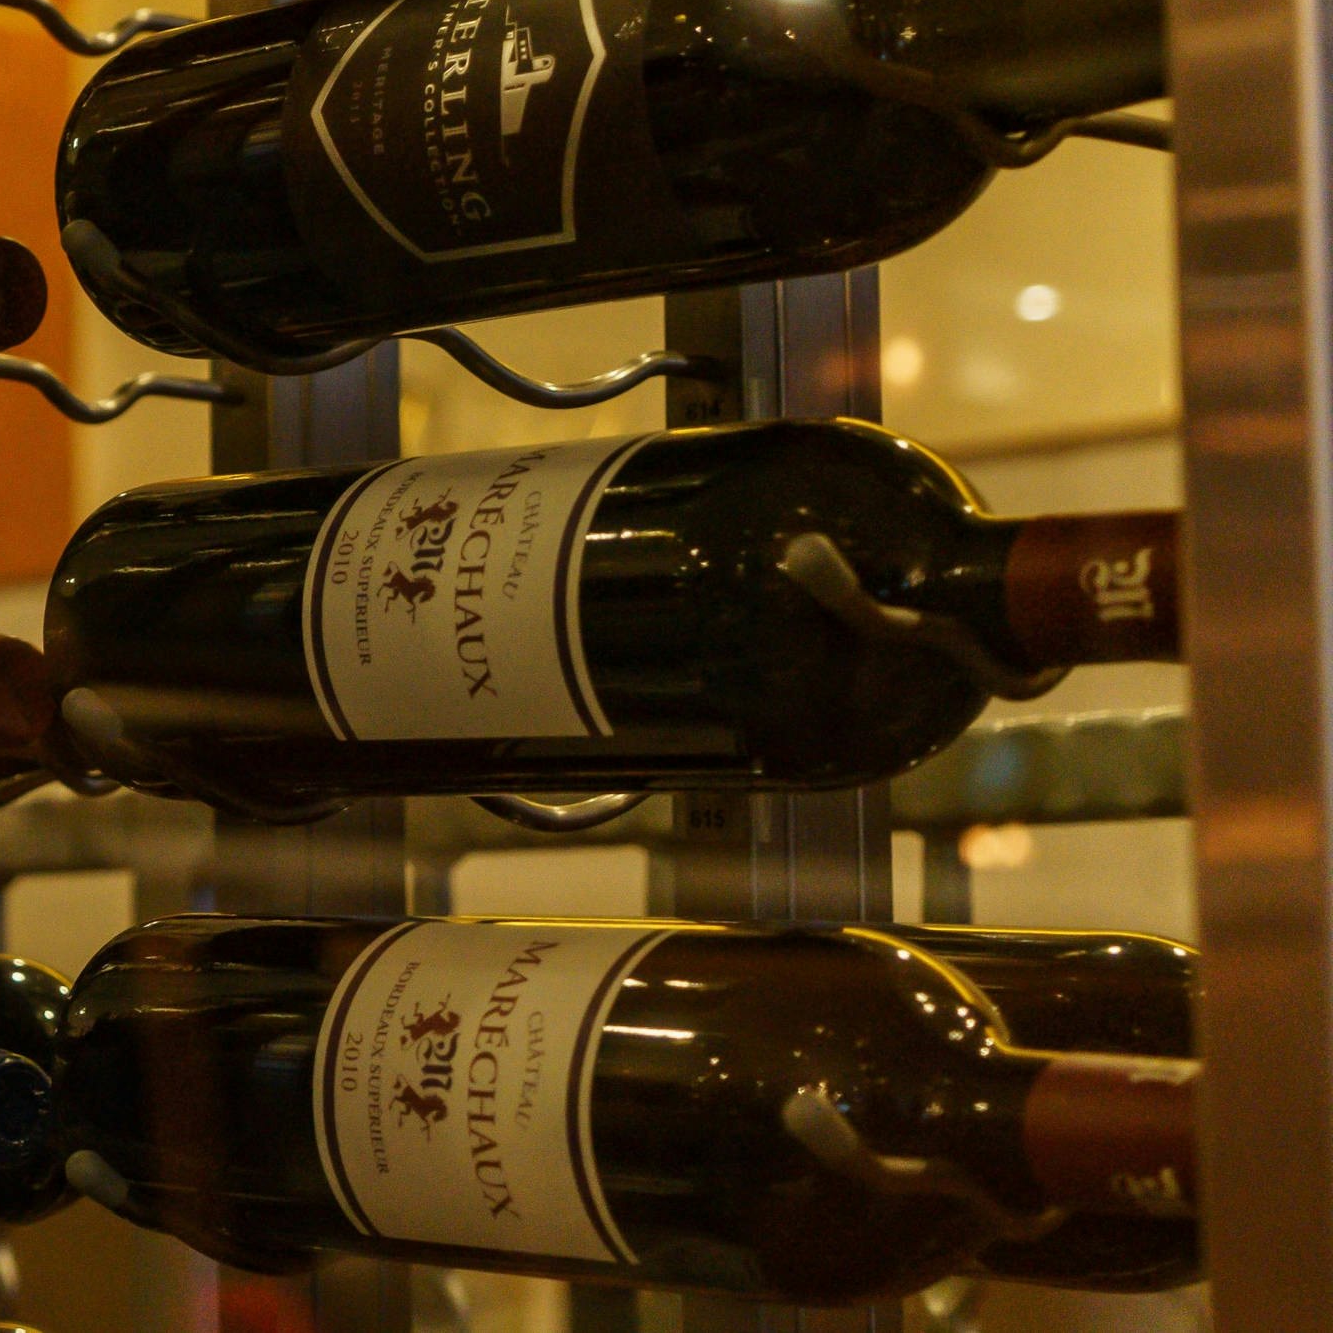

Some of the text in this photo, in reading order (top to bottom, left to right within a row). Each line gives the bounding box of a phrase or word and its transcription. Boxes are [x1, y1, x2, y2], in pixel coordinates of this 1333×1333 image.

[372, 46, 392, 156] MERITAGE
[424, 84, 460, 225] COLLECTION
[331, 530, 360, 585] 2010
[355, 471, 425, 666] BORDEAUX SUPÉRIEUR
[340, 1031, 364, 1093] 2010
[367, 961, 421, 1174] BORDEAUX SUPÉRIEUR
[466, 939, 560, 1221] MARÉCHAUX
